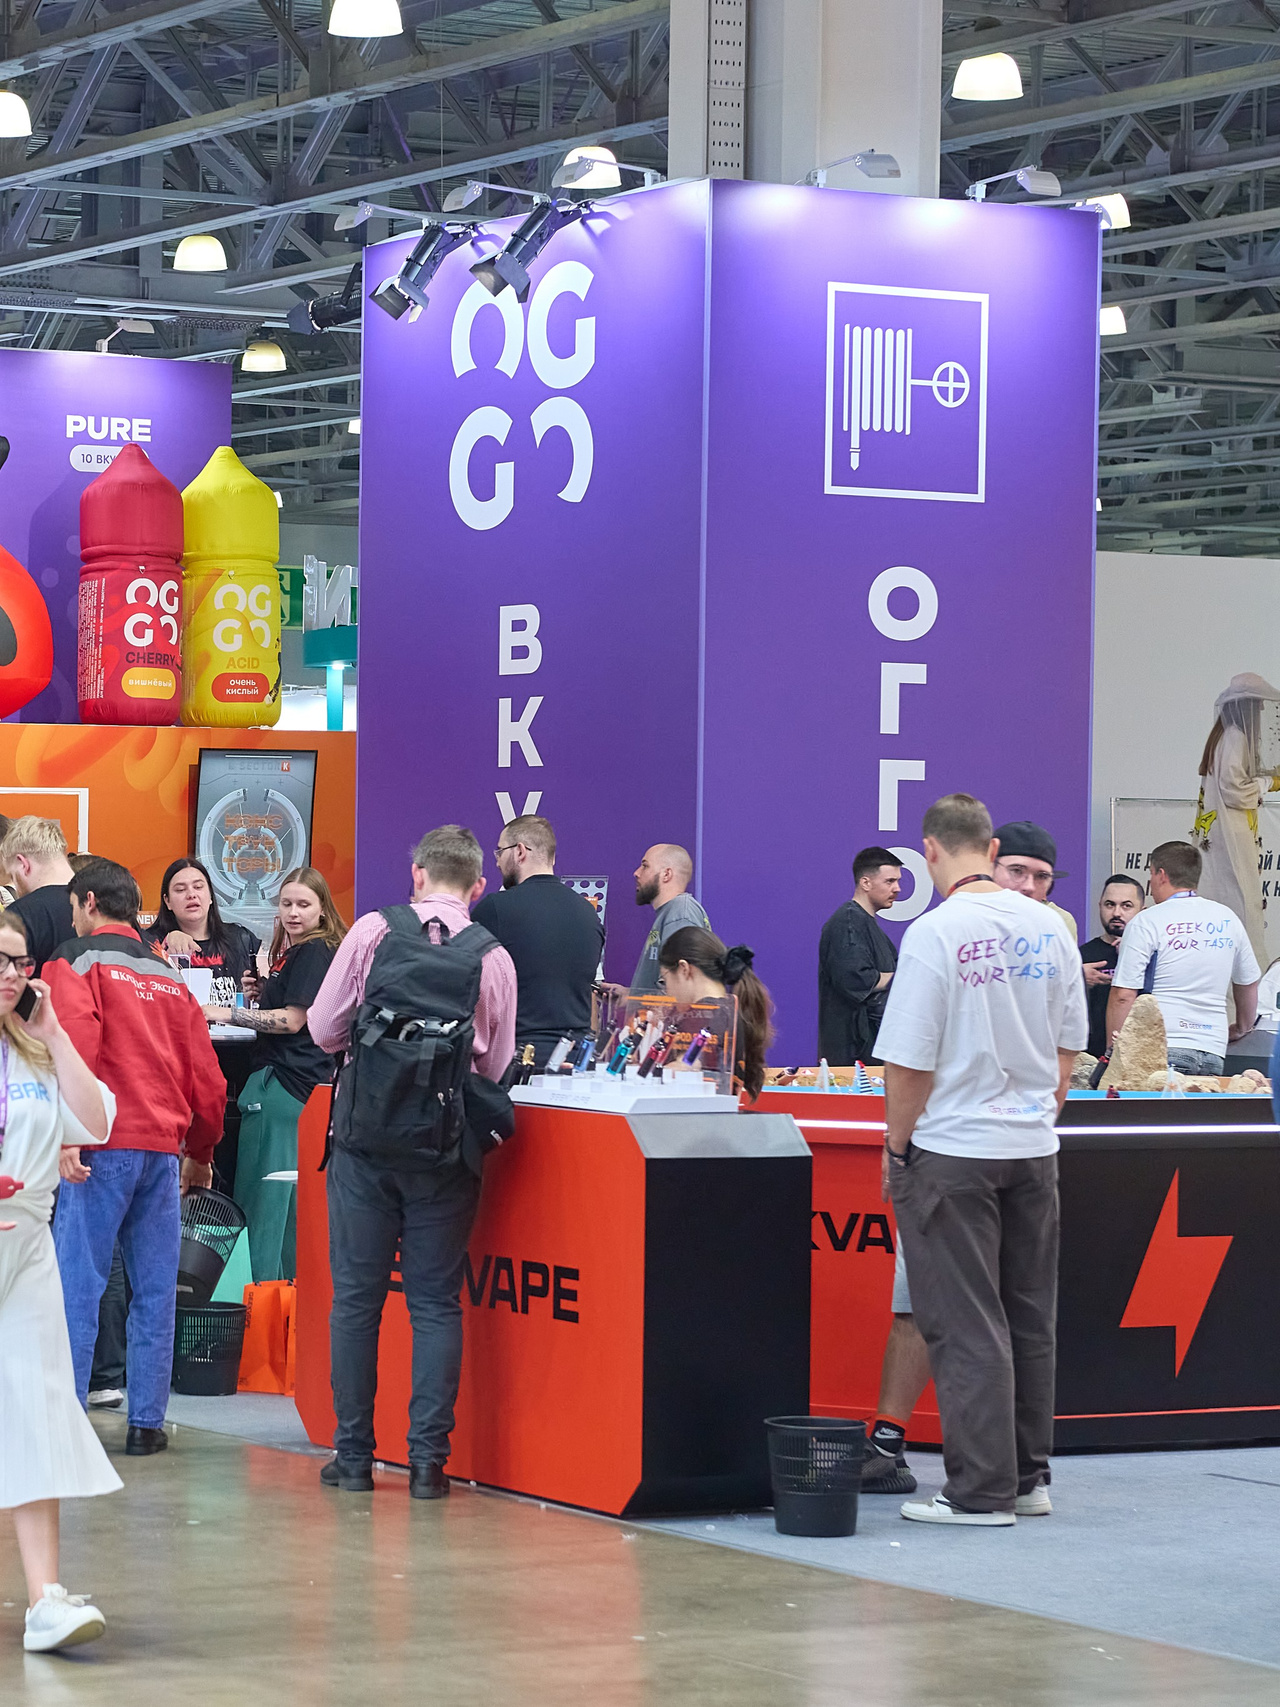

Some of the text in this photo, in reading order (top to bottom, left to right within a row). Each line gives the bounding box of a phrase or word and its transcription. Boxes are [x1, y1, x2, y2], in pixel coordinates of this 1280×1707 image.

[66, 414, 151, 442] PURE
[81, 454, 92, 463] 10
[126, 577, 179, 614] OG
[214, 583, 271, 618] OG
[126, 651, 176, 666] CHERRY
[226, 656, 260, 670] ACID
[128, 678, 173, 688] вишнёвый
[230, 679, 256, 687] очень
[868, 566, 938, 921] ОГГО
[224, 813, 283, 830] КОНС
[222, 857, 280, 873] ТОРЫ
[1125, 853, 1142, 869] НЕ
[1166, 919, 1231, 935] GEEK OUT
[957, 933, 1055, 964] GEEK OUT
[1167, 938, 1200, 951] YOUR
[958, 965, 1008, 989] YOUR
[149, 981, 181, 996] ЭКСПО
[7, 1082, 51, 1102] BAR
